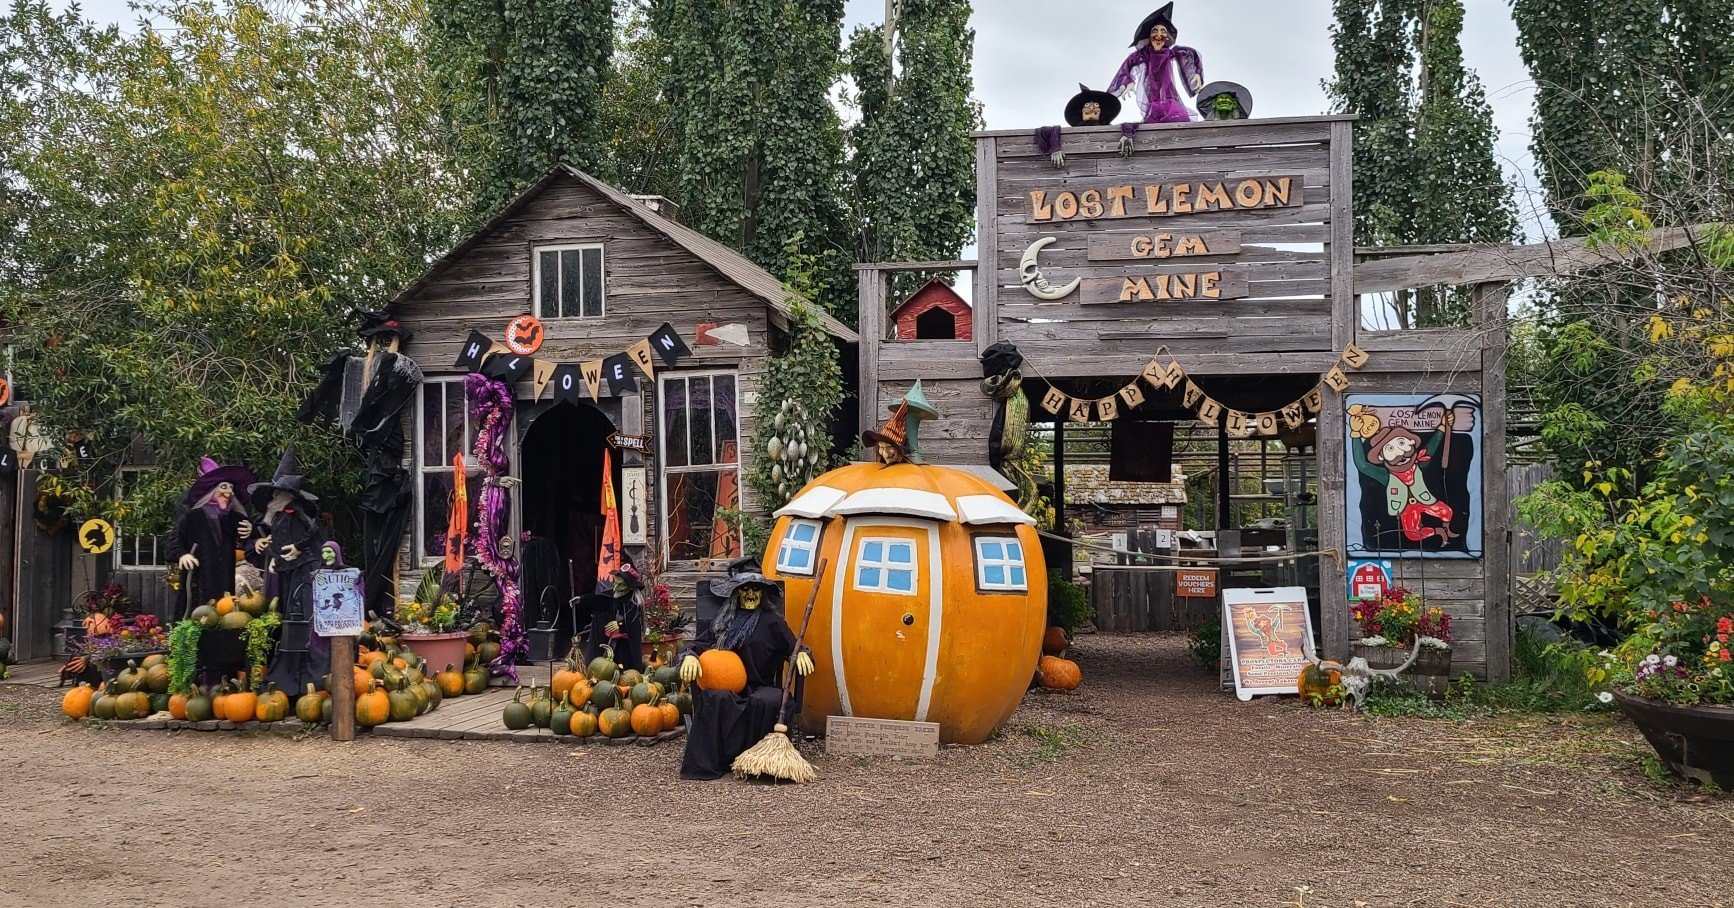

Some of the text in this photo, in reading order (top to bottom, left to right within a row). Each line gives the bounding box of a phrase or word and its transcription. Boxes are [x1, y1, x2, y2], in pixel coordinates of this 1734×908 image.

[1029, 176, 1293, 221] LOST LEMON
[1130, 231, 1209, 258] GEM
[1120, 271, 1222, 301] MINE
[1049, 364, 1161, 417] HAPPY
[1389, 410, 1442, 420] LOST LEMON
[1388, 419, 1436, 428] GEM MINE
[623, 437, 644, 449] SPELL
[1117, 538, 1122, 547] 1
[1161, 534, 1166, 543] 2
